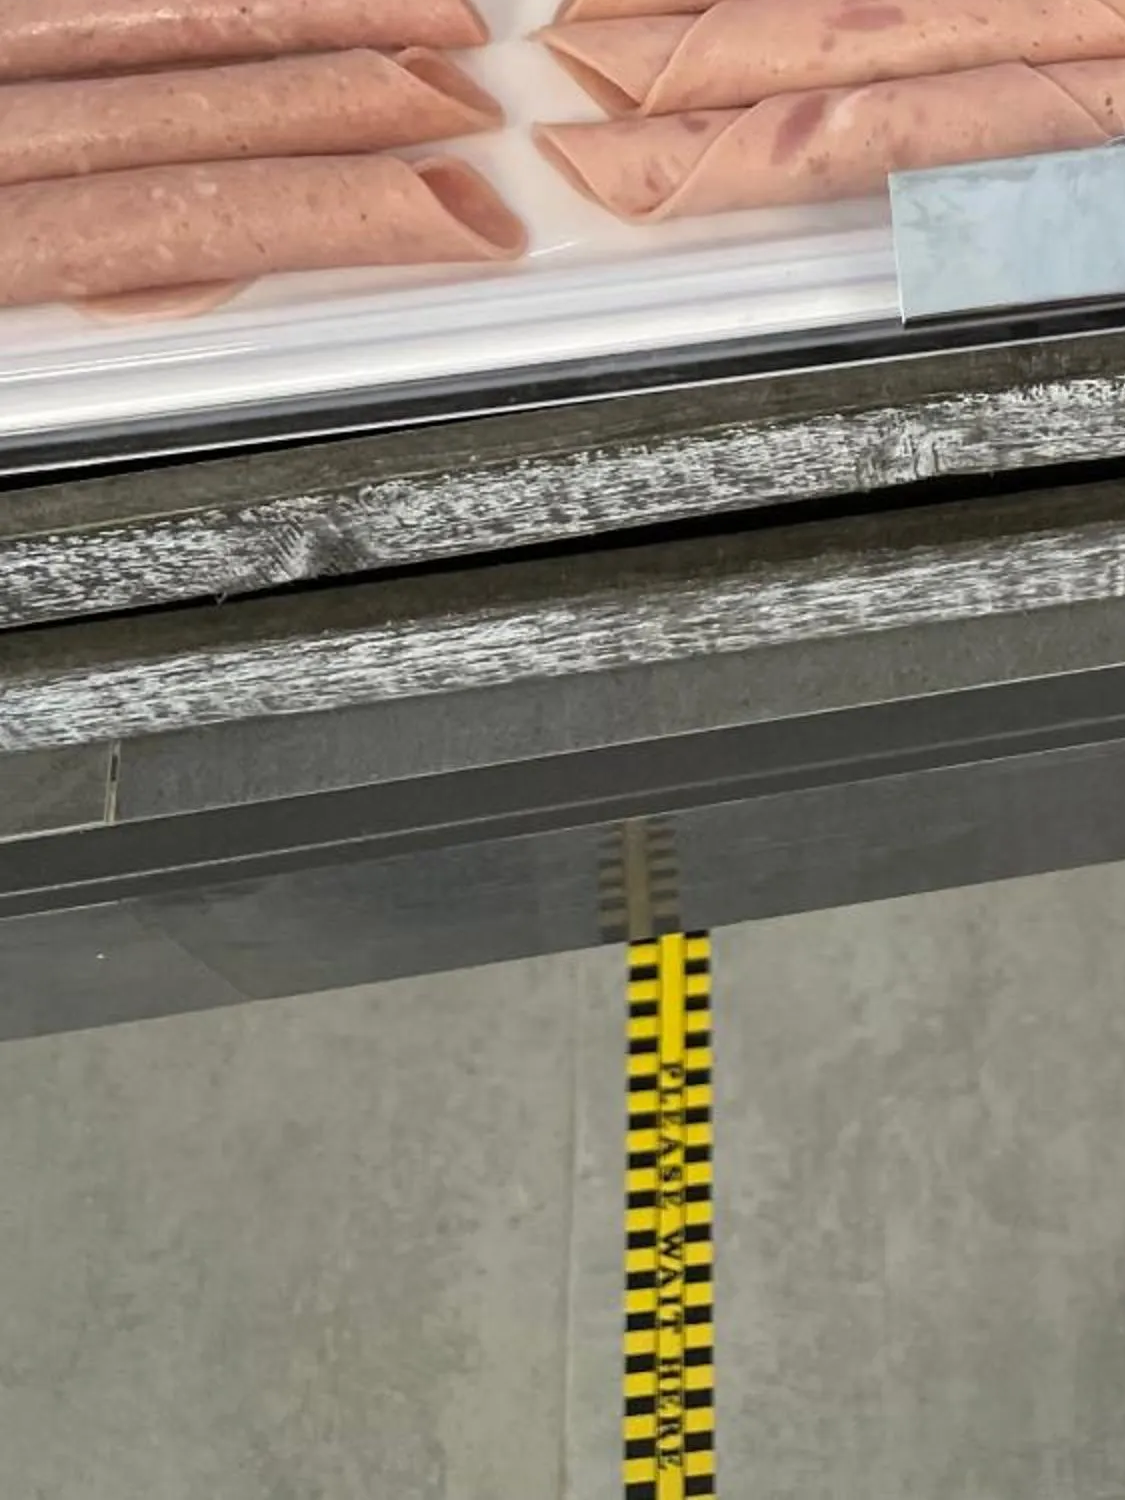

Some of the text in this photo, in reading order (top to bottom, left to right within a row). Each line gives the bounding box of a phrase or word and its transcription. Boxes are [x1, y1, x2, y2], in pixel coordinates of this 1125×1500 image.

[658, 1062, 684, 1470] PLEASE WAIT HERE
